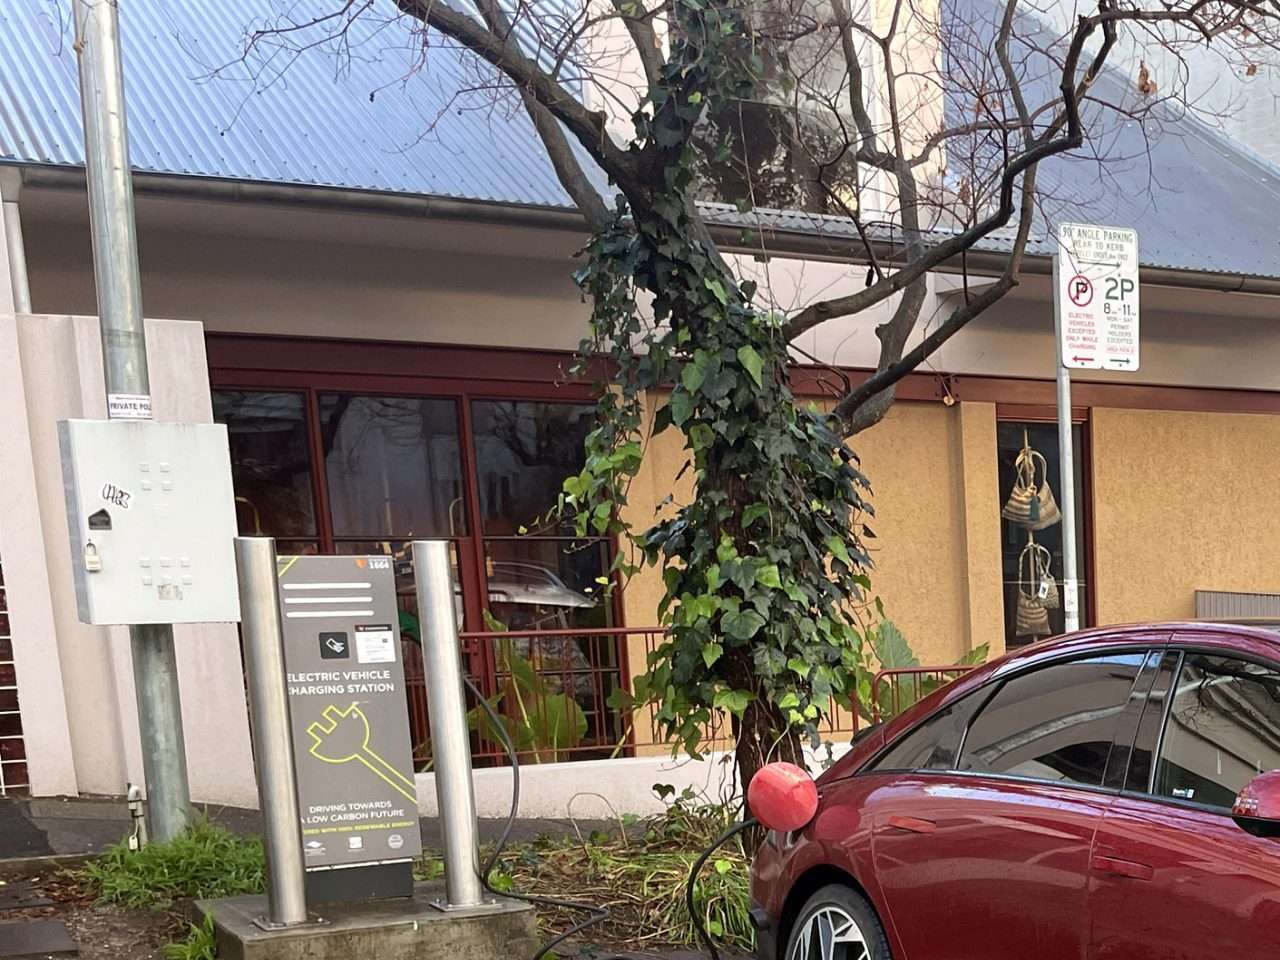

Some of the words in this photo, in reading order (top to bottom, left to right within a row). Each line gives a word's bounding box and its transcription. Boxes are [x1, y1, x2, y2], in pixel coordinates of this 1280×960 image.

[1078, 229, 1100, 240] ANGLE
[1103, 231, 1133, 243] PARKING
[1096, 241, 1103, 250] TO
[1106, 243, 1124, 251] KERB
[1105, 277, 1134, 301] 2P
[1068, 312, 1094, 320] ELECTRIC
[110, 402, 138, 410] PRIVATE
[287, 672, 340, 682] ELECTRIC
[343, 671, 390, 680] VEHICLE
[348, 683, 394, 693] STATION
[309, 804, 346, 814] DRIVING
[348, 800, 392, 810] TOWARDS
[307, 815, 329, 823] LOW
[330, 813, 368, 822] CARBON
[370, 809, 405, 818] FUTURE
